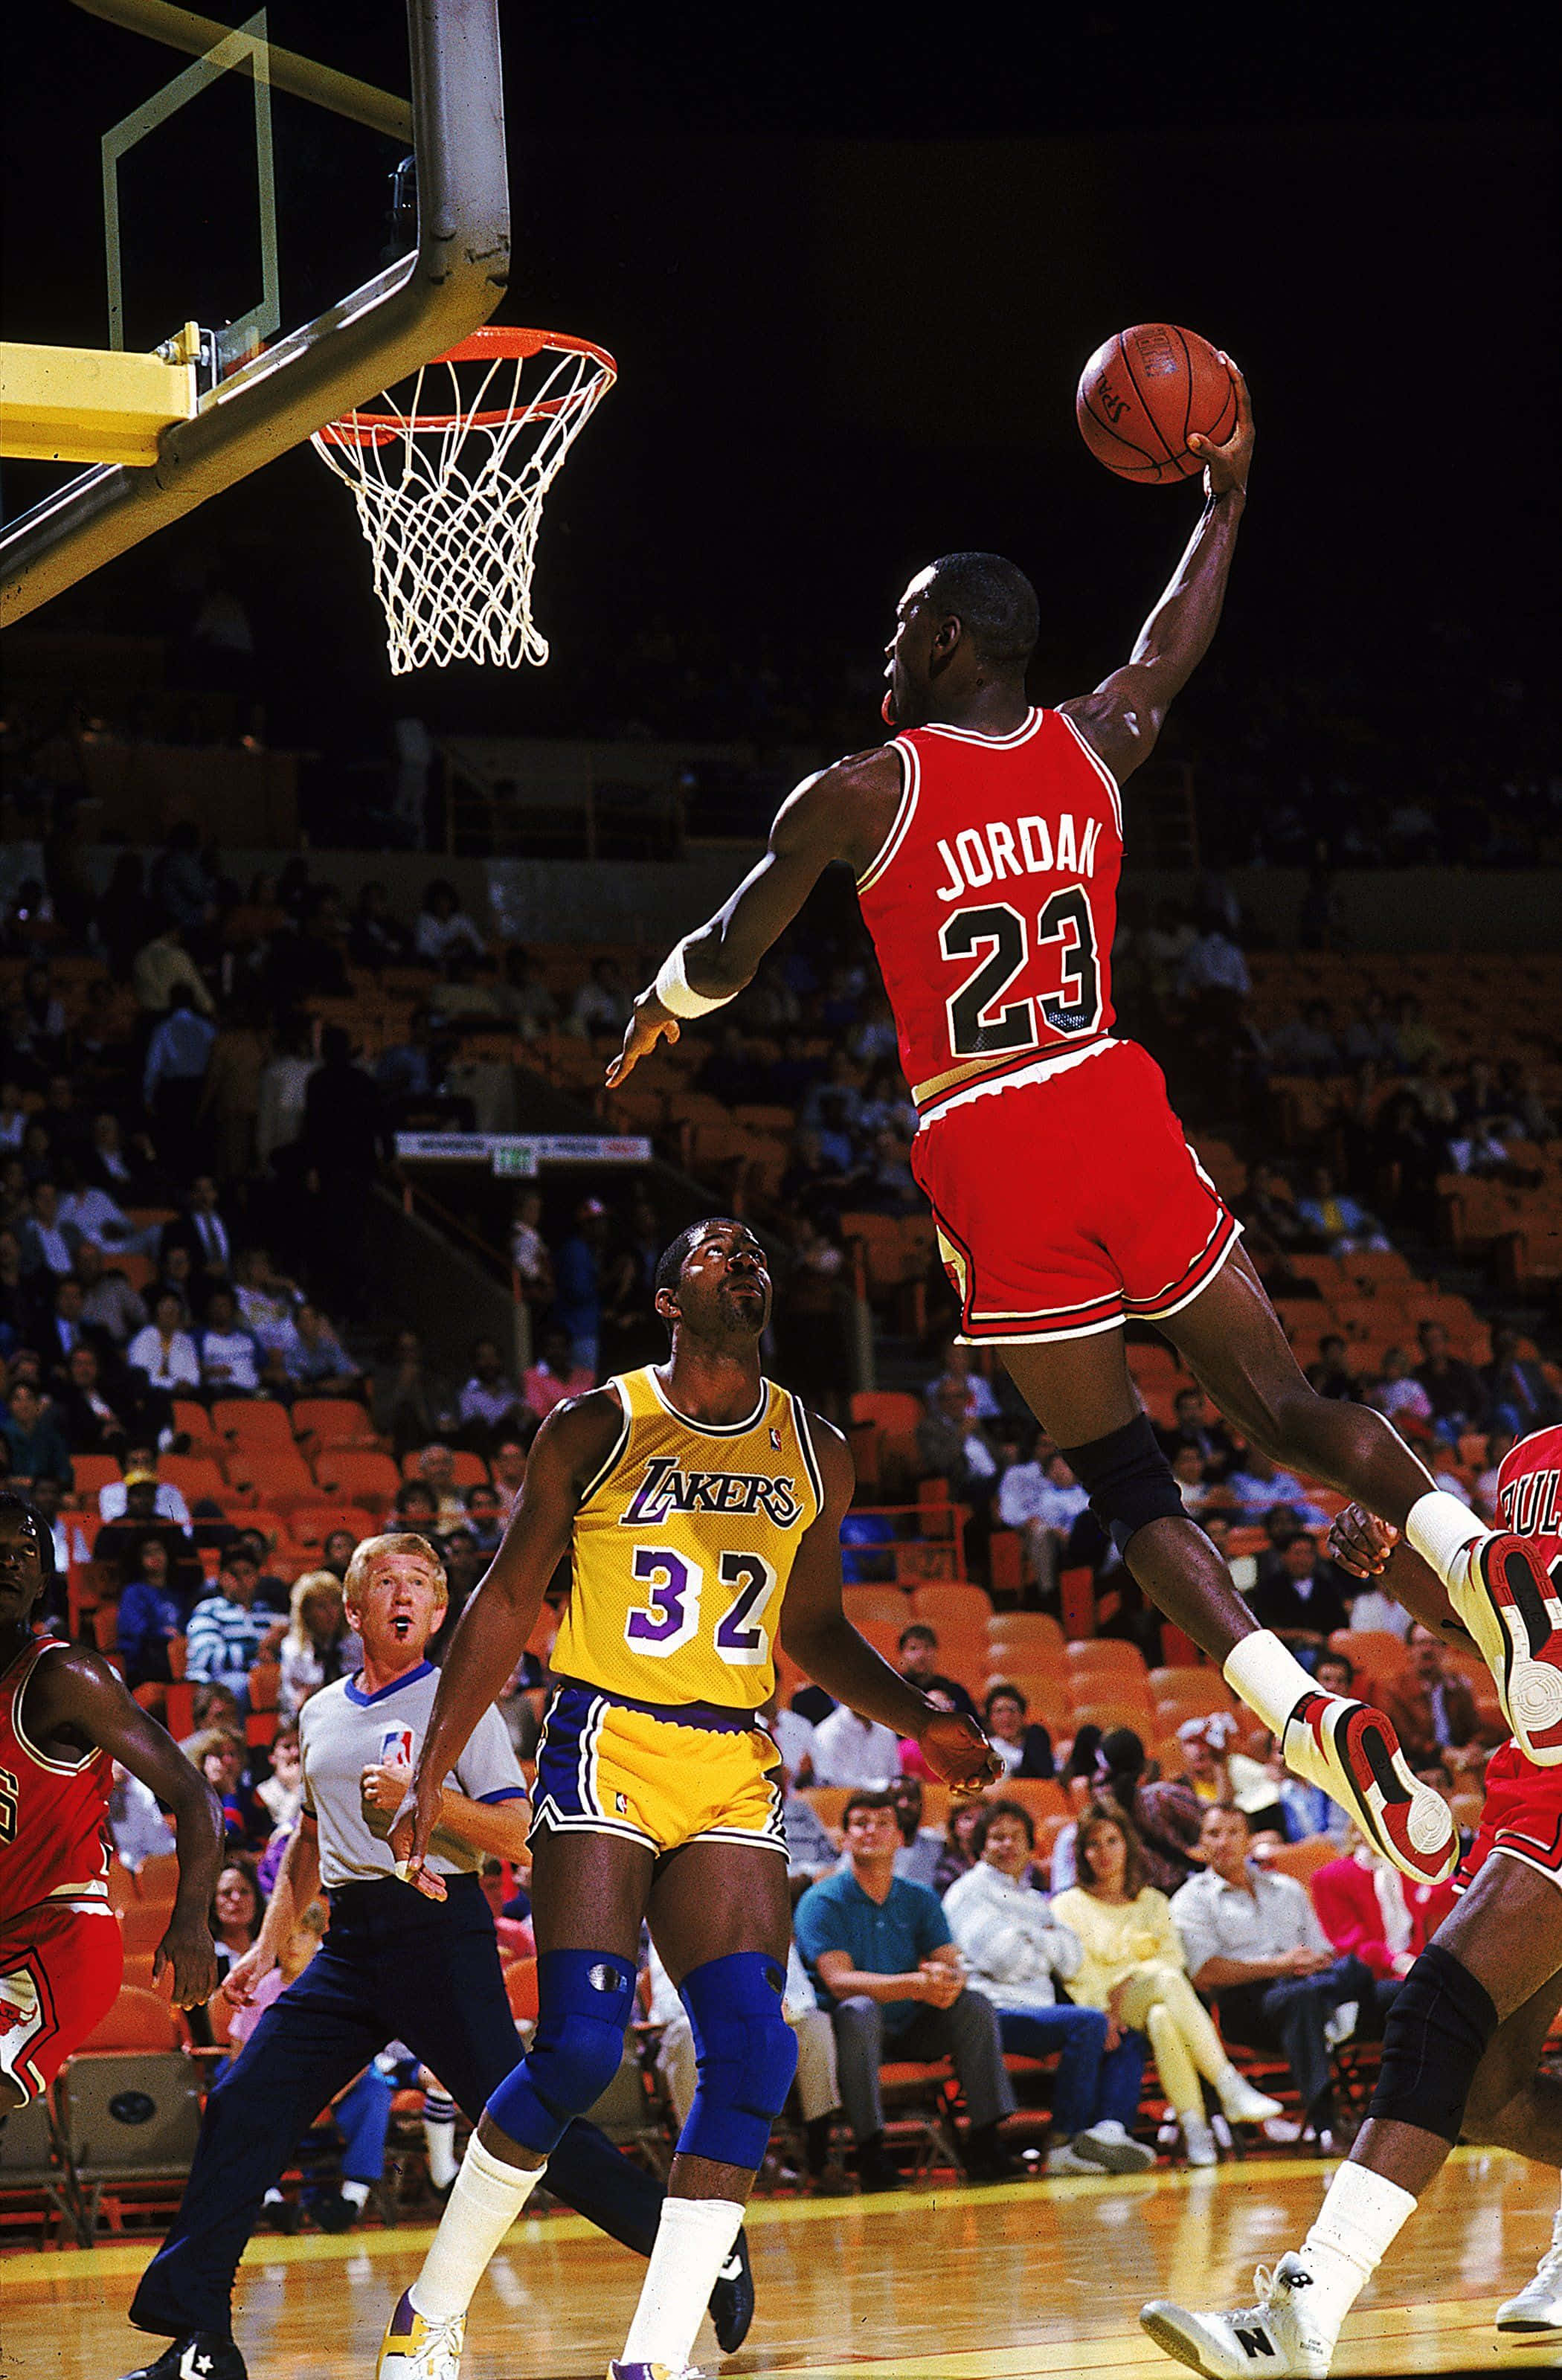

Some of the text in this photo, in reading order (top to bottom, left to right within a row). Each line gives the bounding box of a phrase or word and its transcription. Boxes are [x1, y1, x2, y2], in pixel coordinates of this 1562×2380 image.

[936, 814, 1102, 901] JORDAN
[938, 884, 1103, 1058] 23
[619, 1456, 803, 1530] LAKERS
[623, 1545, 778, 1665] 32
[1234, 2327, 1276, 2358] N
